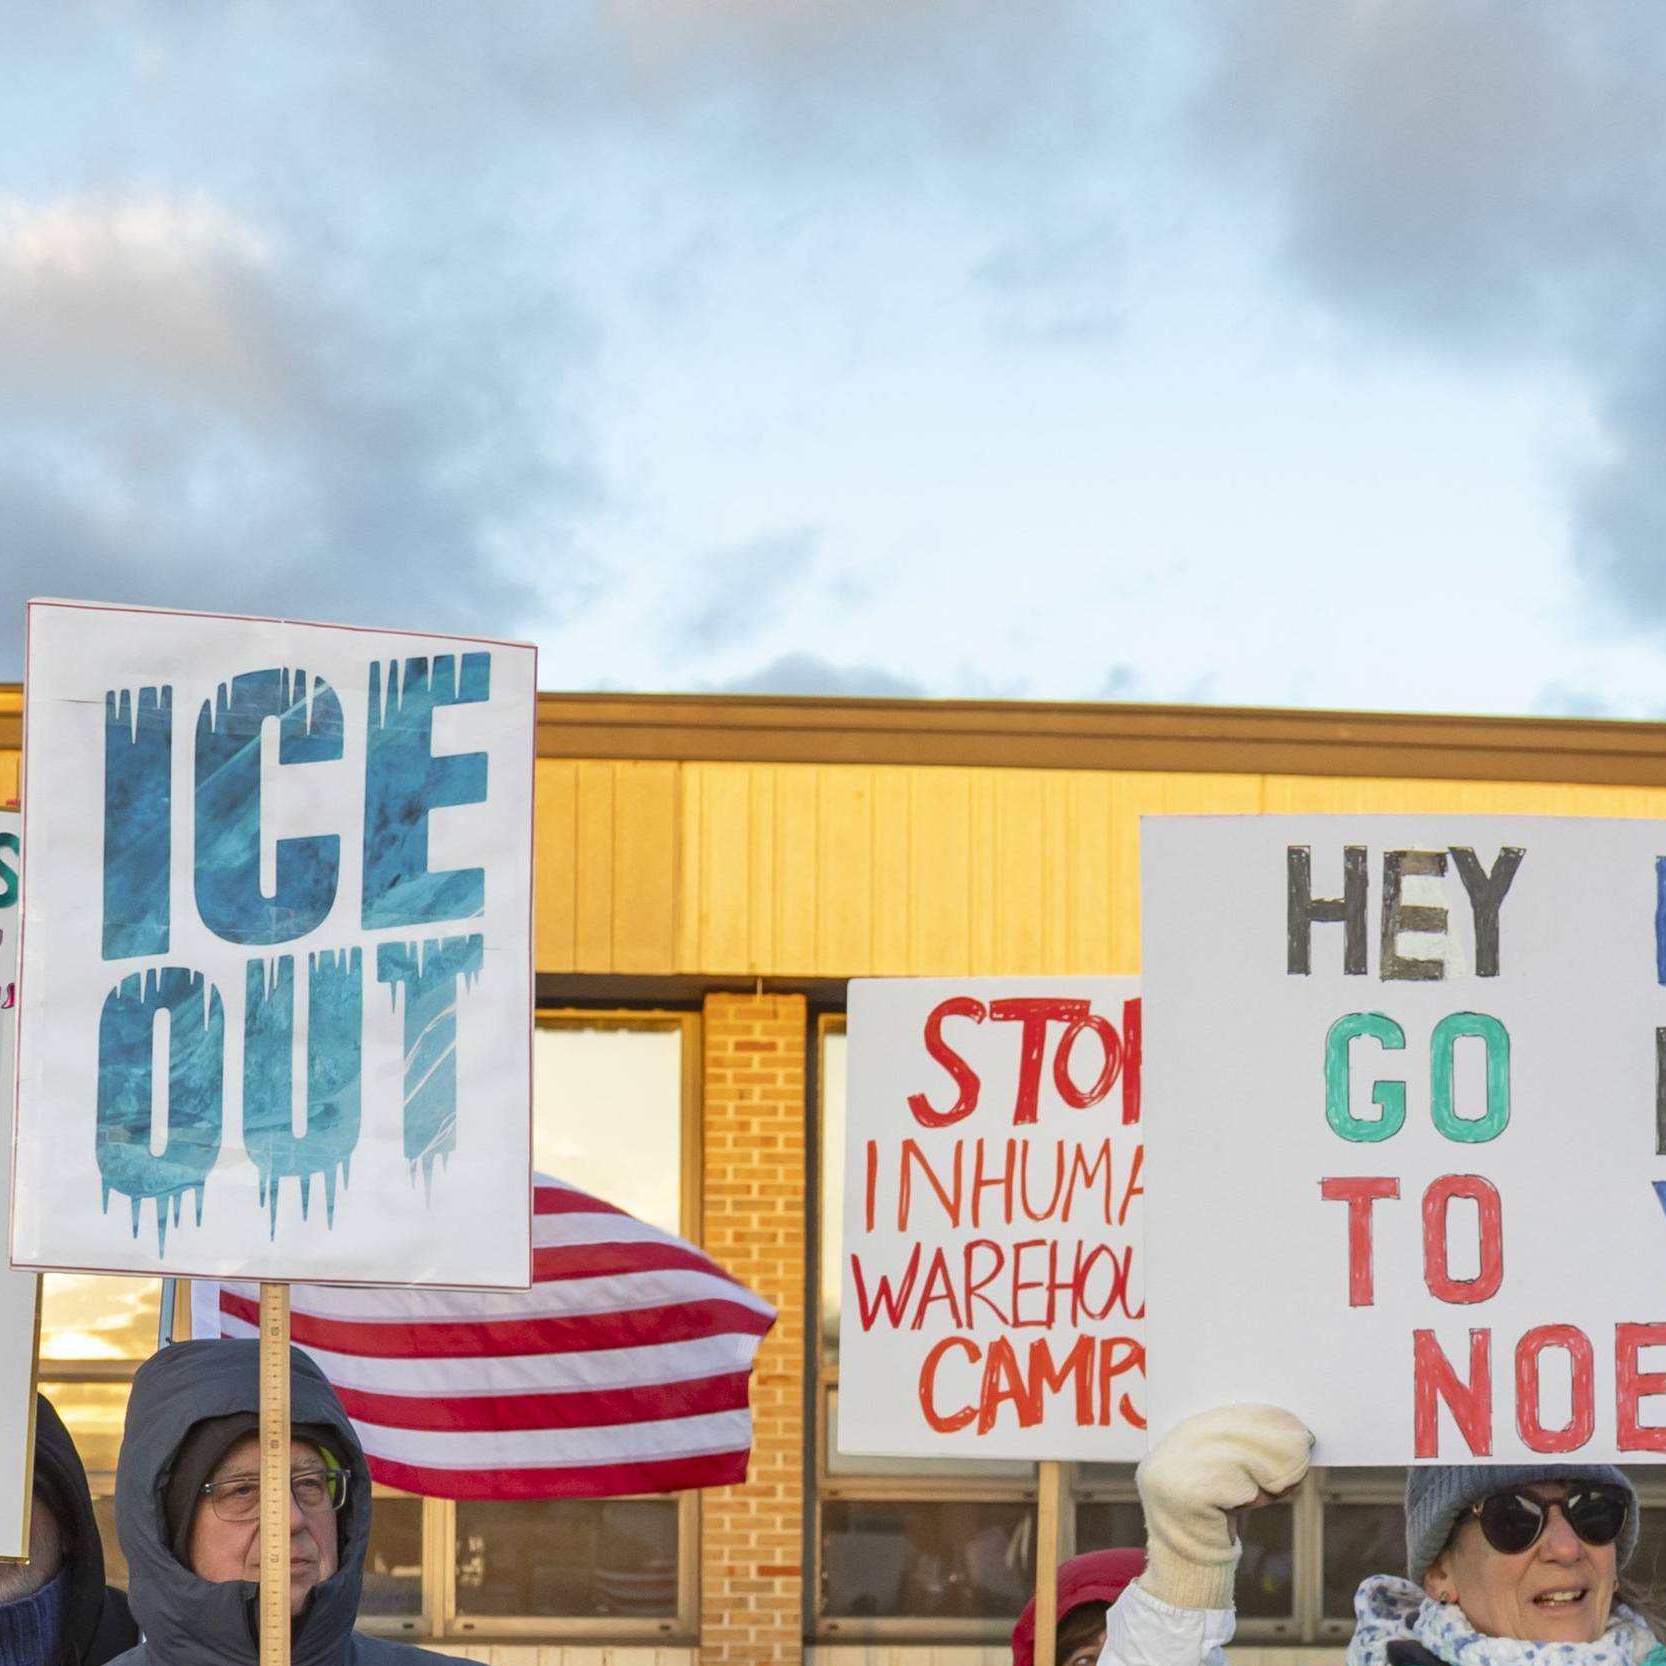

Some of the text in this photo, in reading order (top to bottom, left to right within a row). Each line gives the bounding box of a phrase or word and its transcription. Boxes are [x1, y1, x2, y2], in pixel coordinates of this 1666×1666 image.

[101, 651, 491, 962] ICE
[1286, 845, 1528, 983] HEY
[95, 933, 485, 1259] OUT
[1323, 1011, 1511, 1145] GO
[1318, 1173, 1504, 1308] TO
